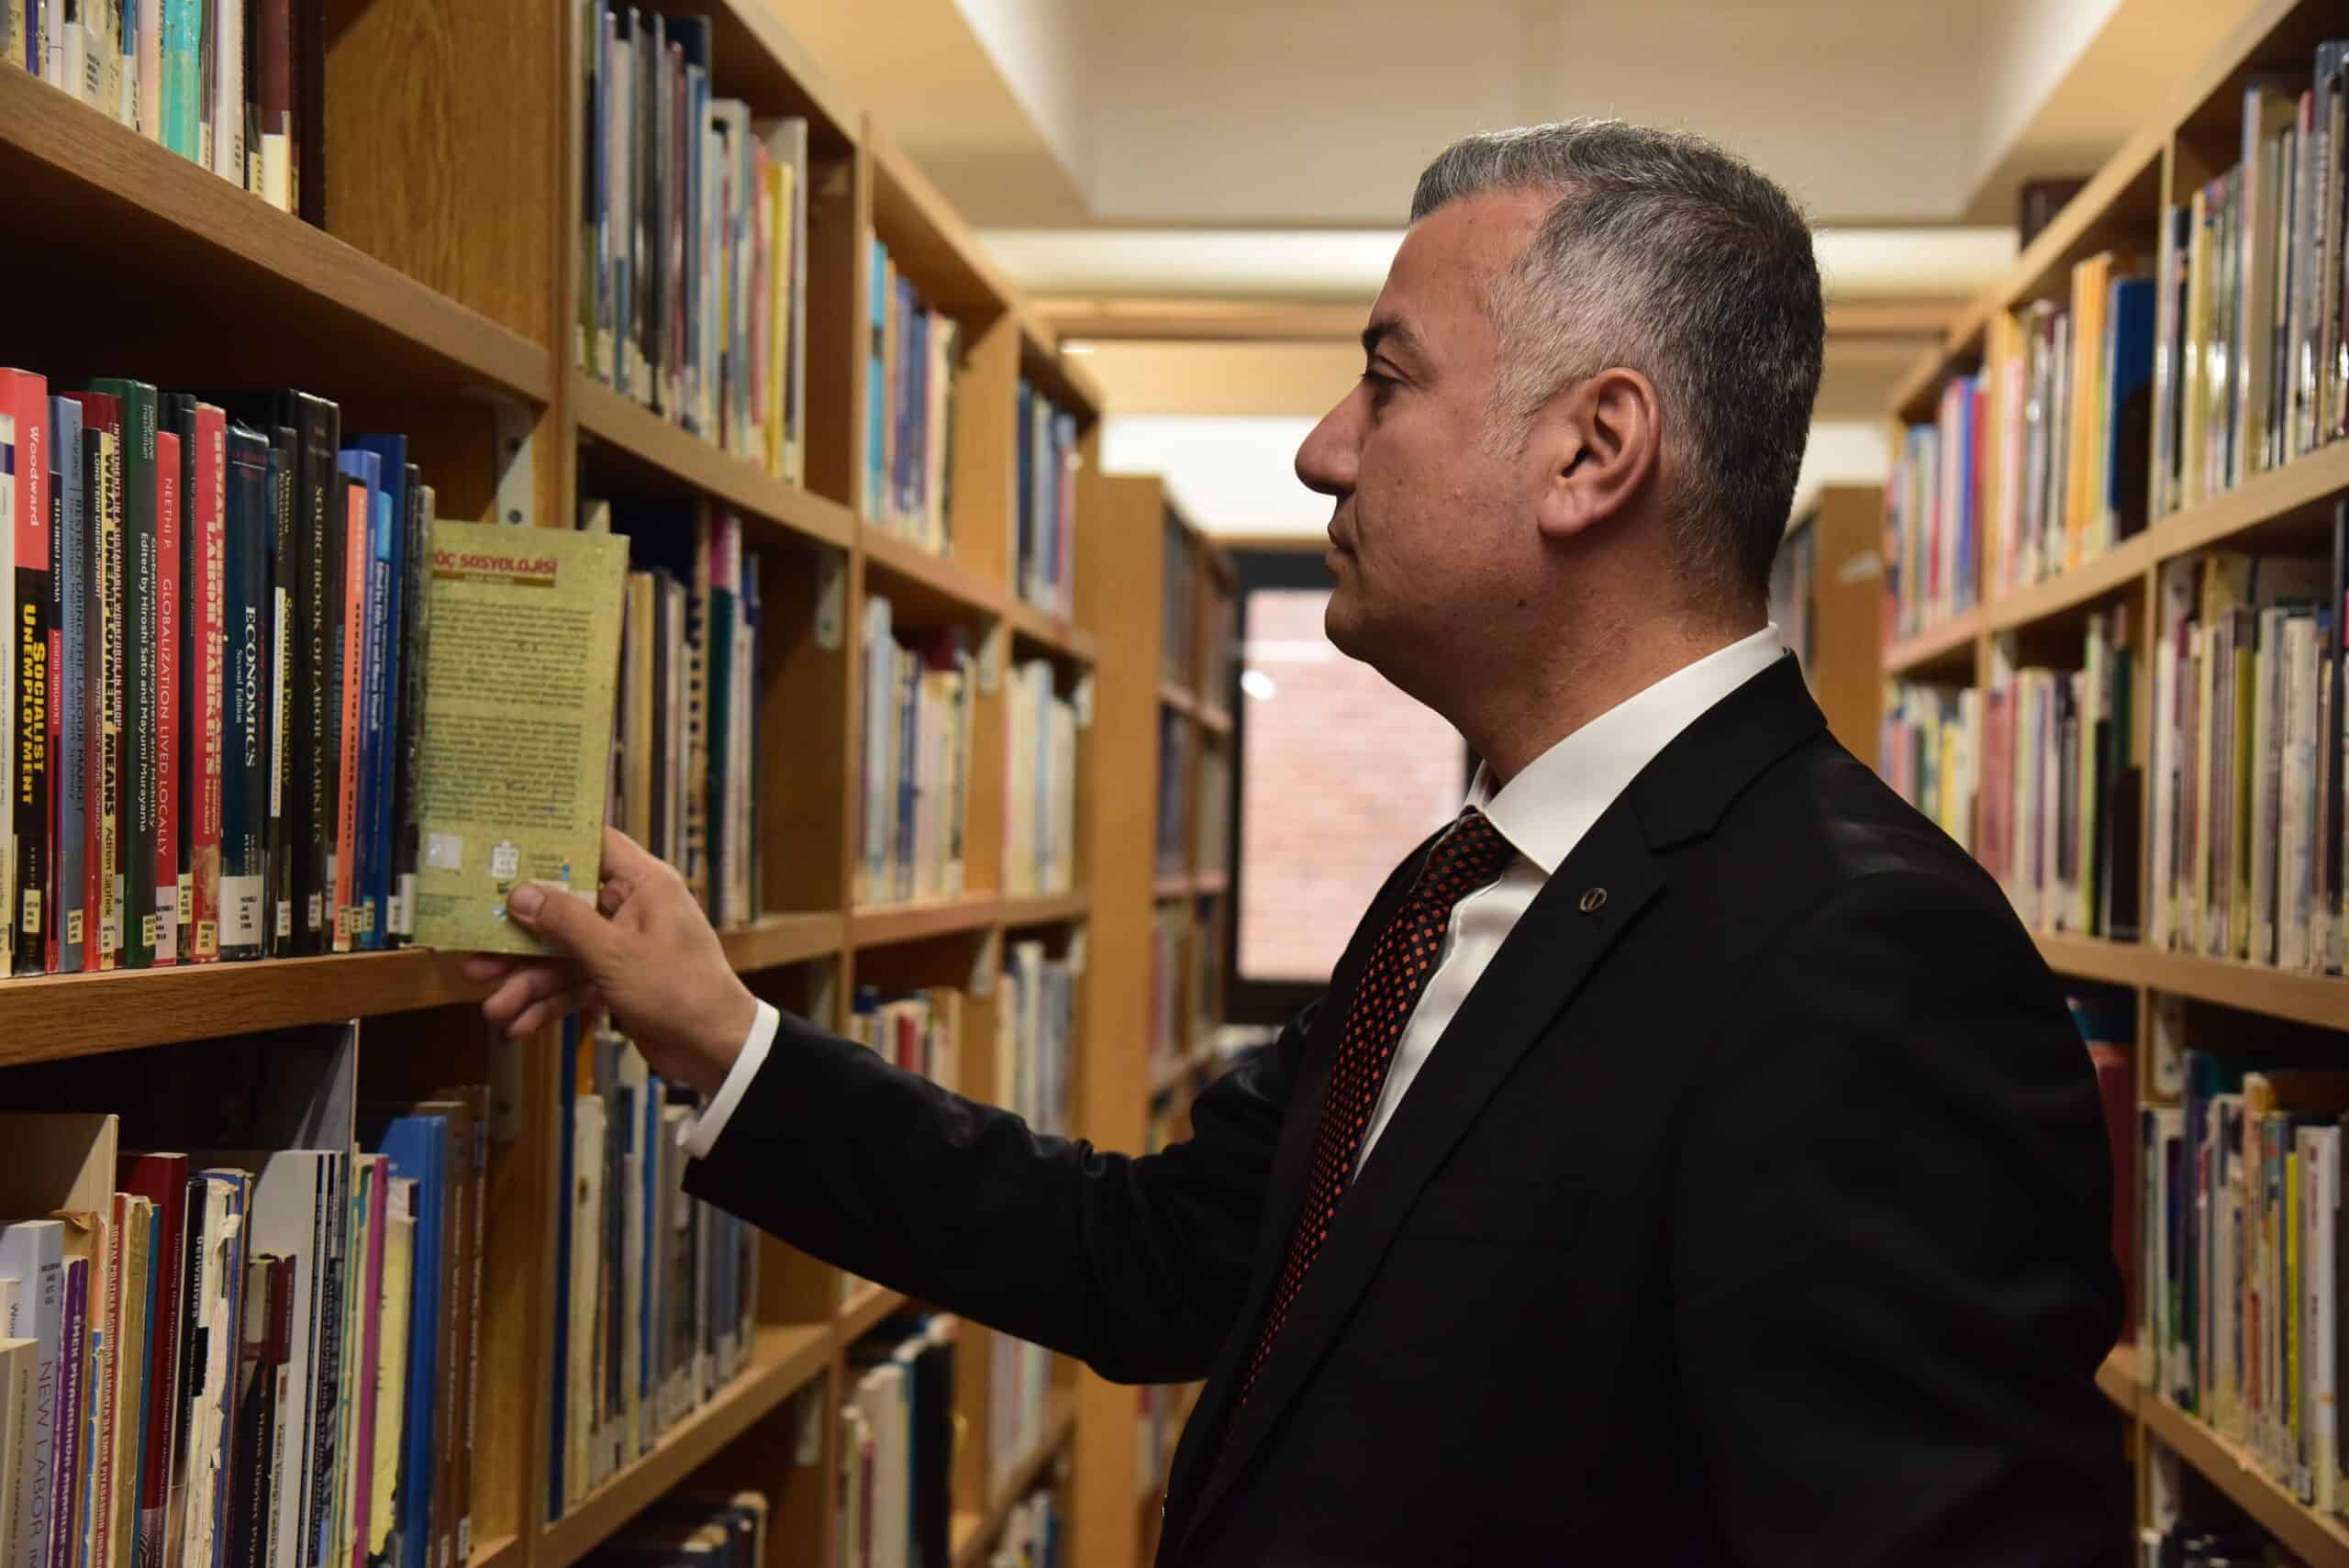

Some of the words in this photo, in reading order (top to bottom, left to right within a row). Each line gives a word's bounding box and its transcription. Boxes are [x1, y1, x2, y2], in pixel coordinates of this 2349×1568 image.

[28, 425, 40, 528] Woodward
[94, 452, 102, 513] LONG-TERM
[105, 454, 115, 521] WHAT
[163, 477, 173, 534] NEETHI
[139, 577, 149, 593] by
[140, 533, 149, 574] Edited
[314, 484, 323, 631] SOURCEBOOK
[432, 548, 456, 570] ÖÇ
[105, 530, 115, 725] UNEMPLOYMENT
[140, 596, 149, 644] Hiroshi
[160, 578, 172, 719] GLOBALIZATION
[139, 646, 148, 677] Sato
[139, 680, 148, 704] and
[236, 649, 244, 684] Second
[245, 606, 257, 768] ECONOMICS
[22, 604, 36, 806] UNEMPLOYMENT
[32, 642, 45, 774] SOCIALIST
[138, 707, 148, 760] Mayumi
[236, 688, 244, 724] Edition
[104, 733, 115, 817] MEANS
[159, 726, 170, 773] LIVED
[138, 763, 147, 832] Murayama
[158, 780, 169, 856] LOCALLY
[105, 827, 115, 871] Adrian
[191, 1234, 205, 1319] Derivatives
[37, 1361, 53, 1428] NEW
[30, 1439, 49, 1540] LABOR
